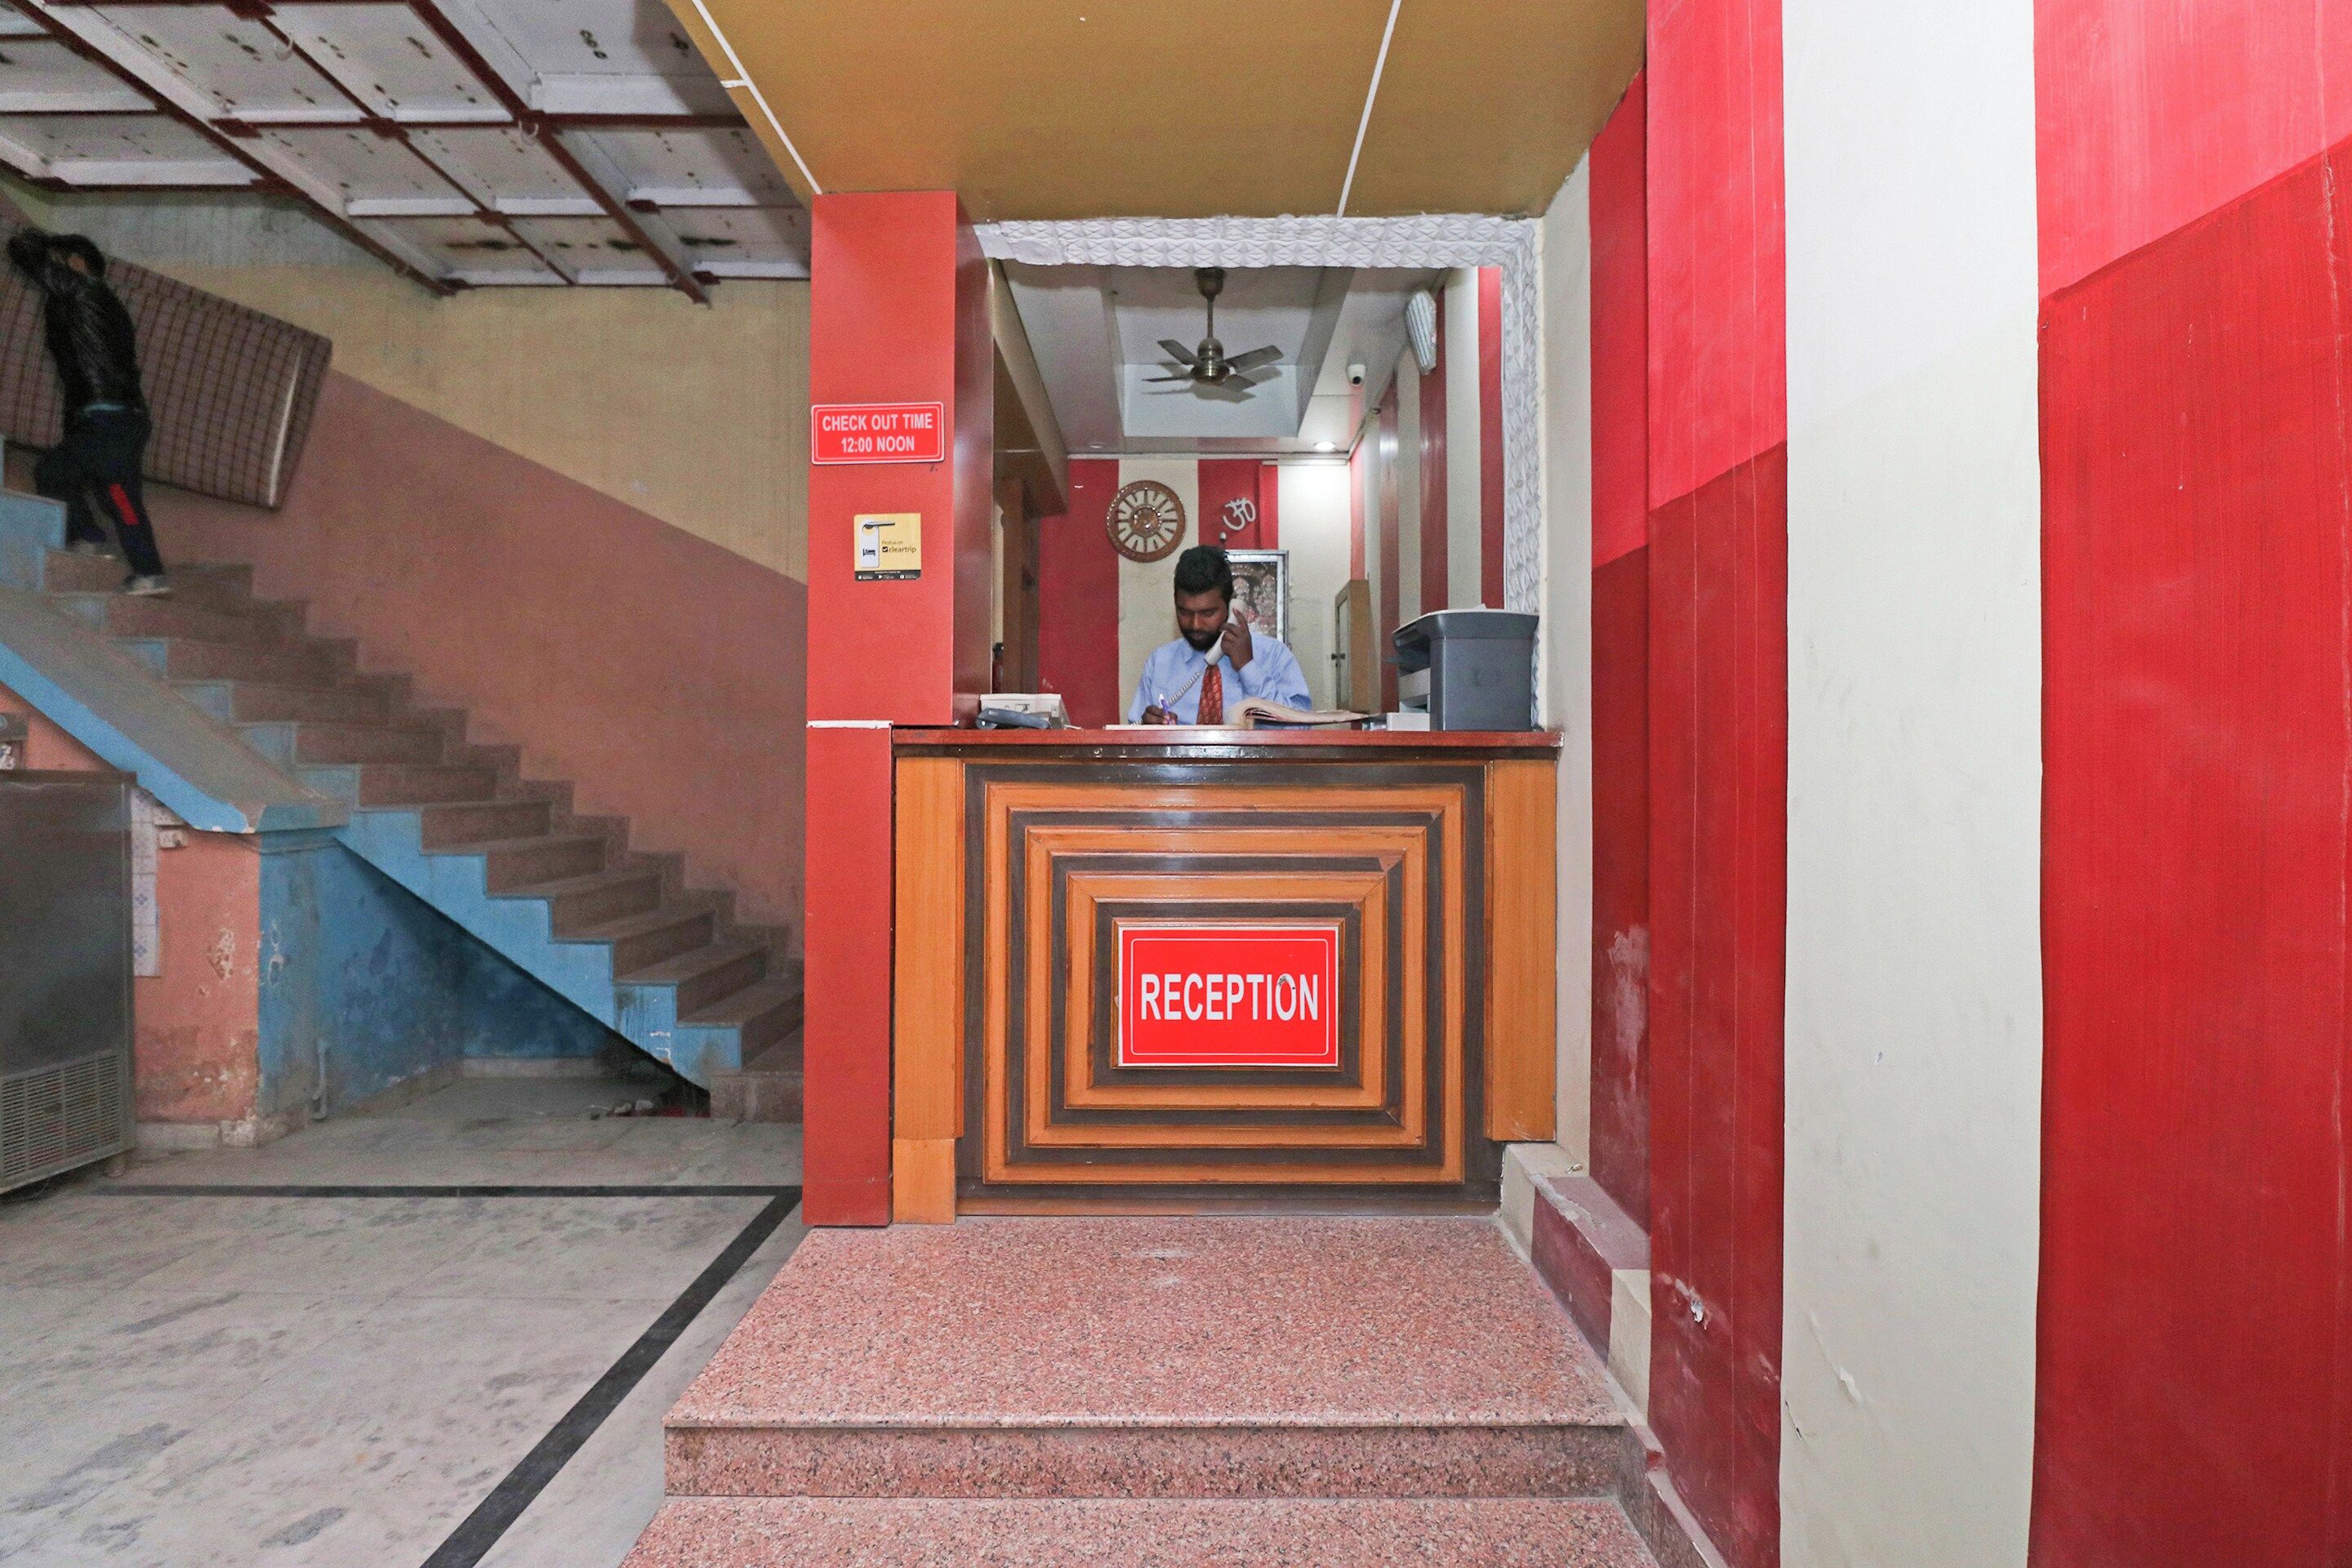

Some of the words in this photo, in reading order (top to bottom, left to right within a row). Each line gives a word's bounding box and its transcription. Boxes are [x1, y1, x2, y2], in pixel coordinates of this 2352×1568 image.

[822, 415, 867, 431] CHECK
[871, 414, 898, 430] OUT
[902, 412, 933, 430] TIME
[841, 437, 872, 453] 12:00
[877, 436, 915, 452] NOON
[889, 546, 917, 554] cleartrip
[1141, 973, 1318, 1021] RECEPTION
